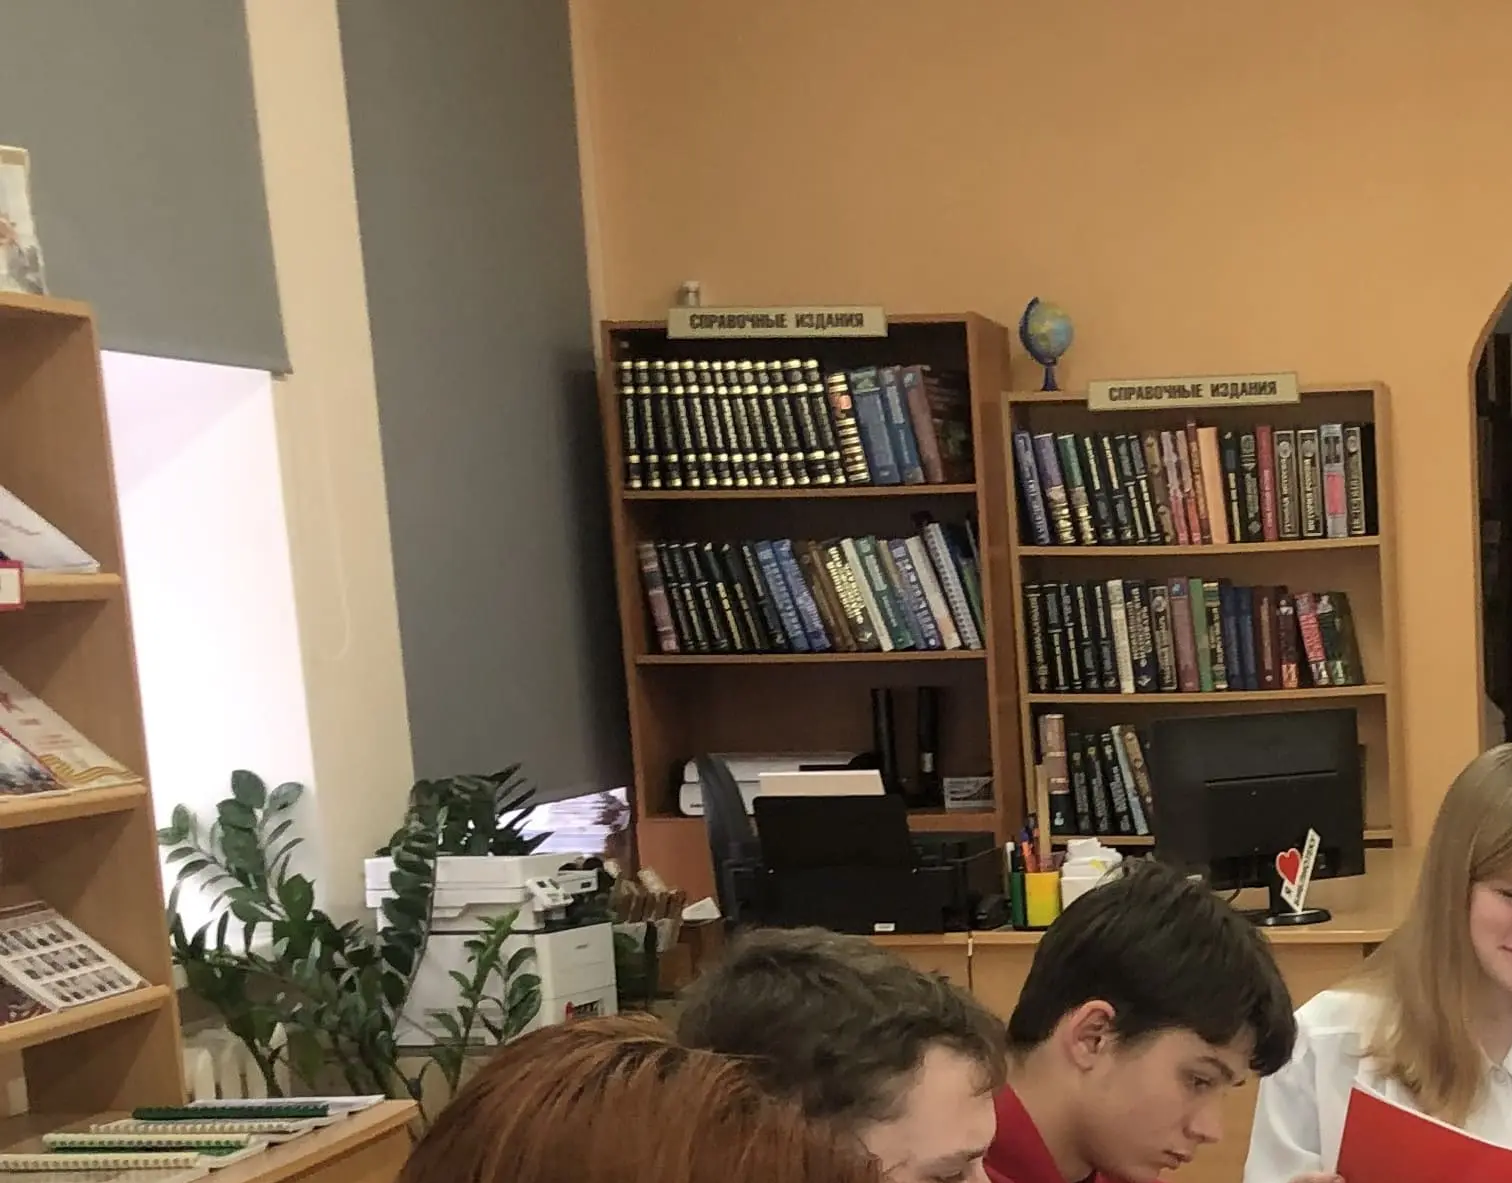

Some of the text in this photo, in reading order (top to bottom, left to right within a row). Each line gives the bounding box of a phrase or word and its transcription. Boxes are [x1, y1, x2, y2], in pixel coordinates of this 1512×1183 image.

[689, 312, 864, 330] СПРАВОЧНЫЕ ИЗДАНИЯ
[1108, 380, 1277, 401] СПРАВОЧНЫЕ ИЗДАНИЯ
